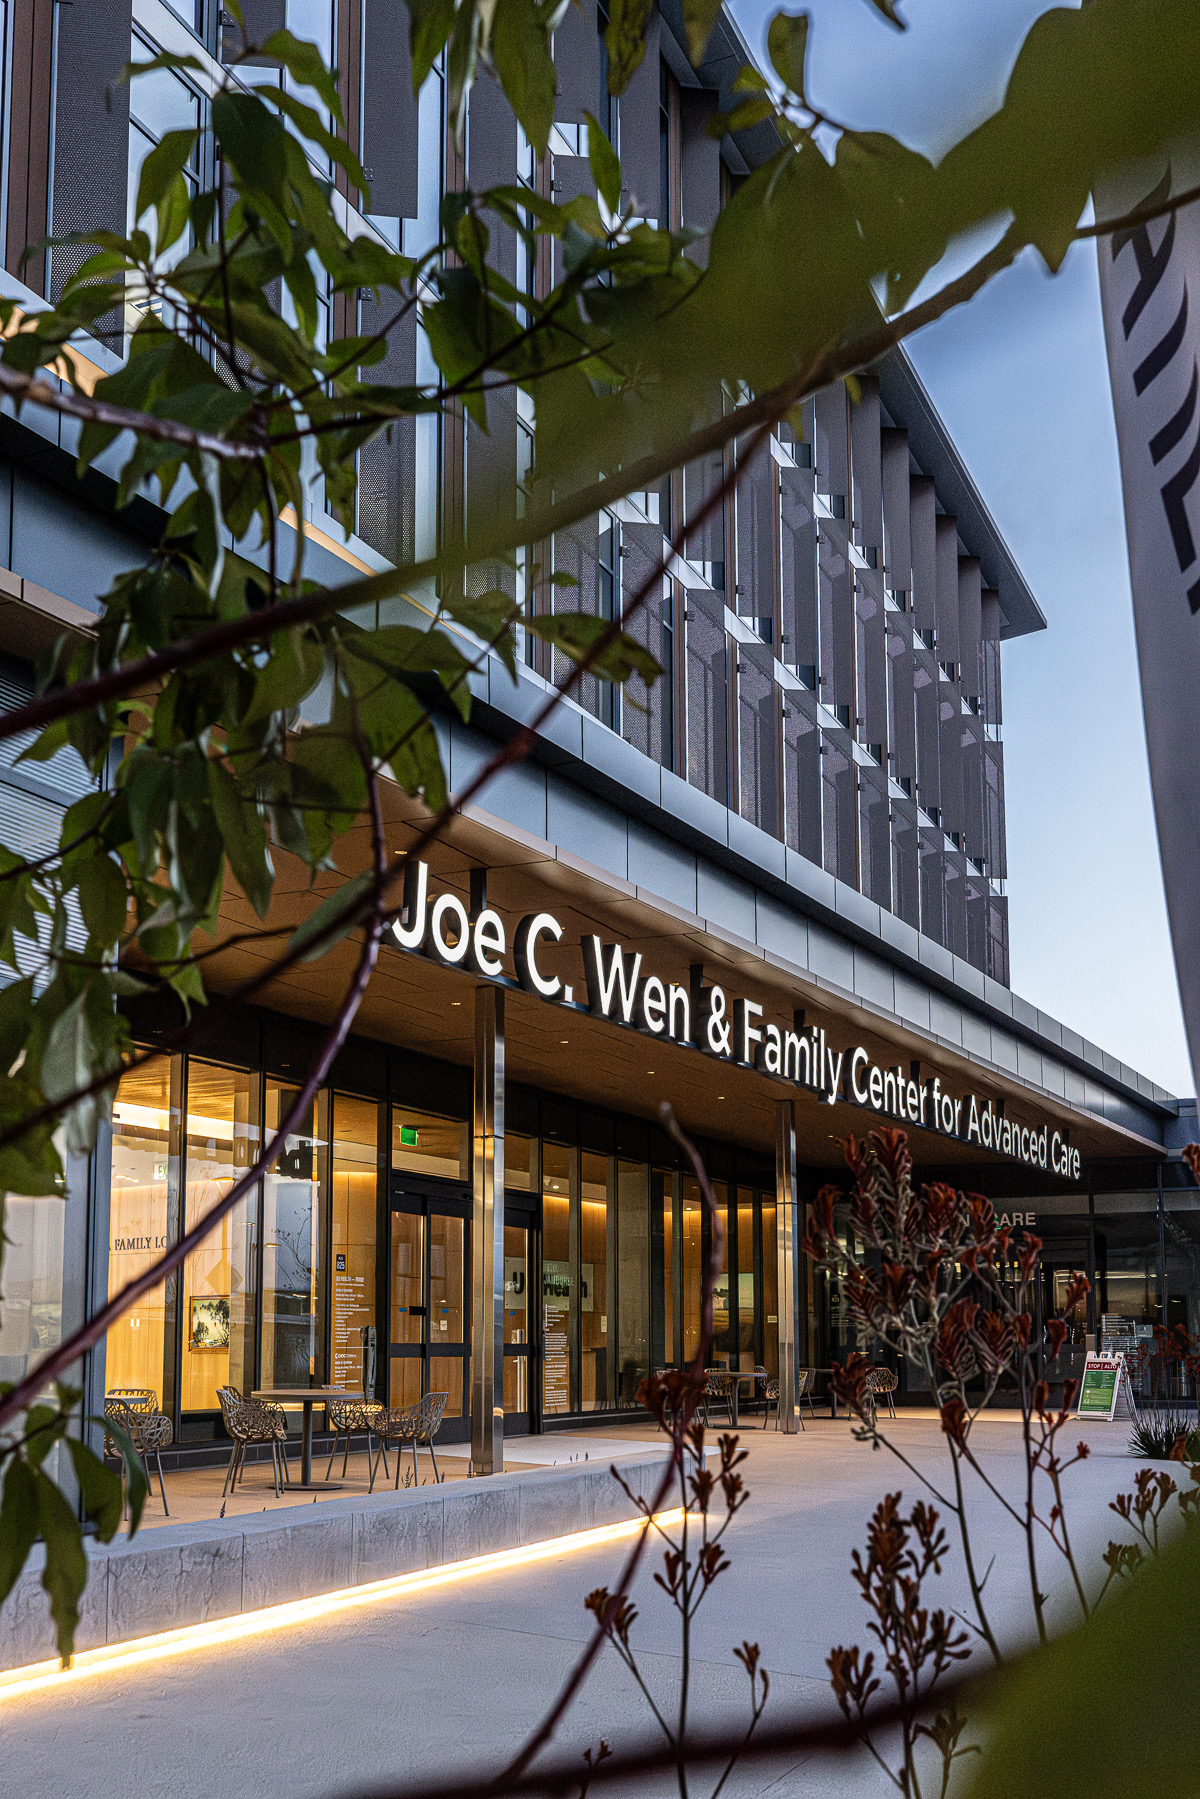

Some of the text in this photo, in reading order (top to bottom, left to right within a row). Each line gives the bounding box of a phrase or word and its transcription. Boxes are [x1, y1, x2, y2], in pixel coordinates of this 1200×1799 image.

[392, 860, 1080, 1180] Joe C. Wen & Family Center for Advanced Care
[115, 1237, 151, 1250] FAMILY
